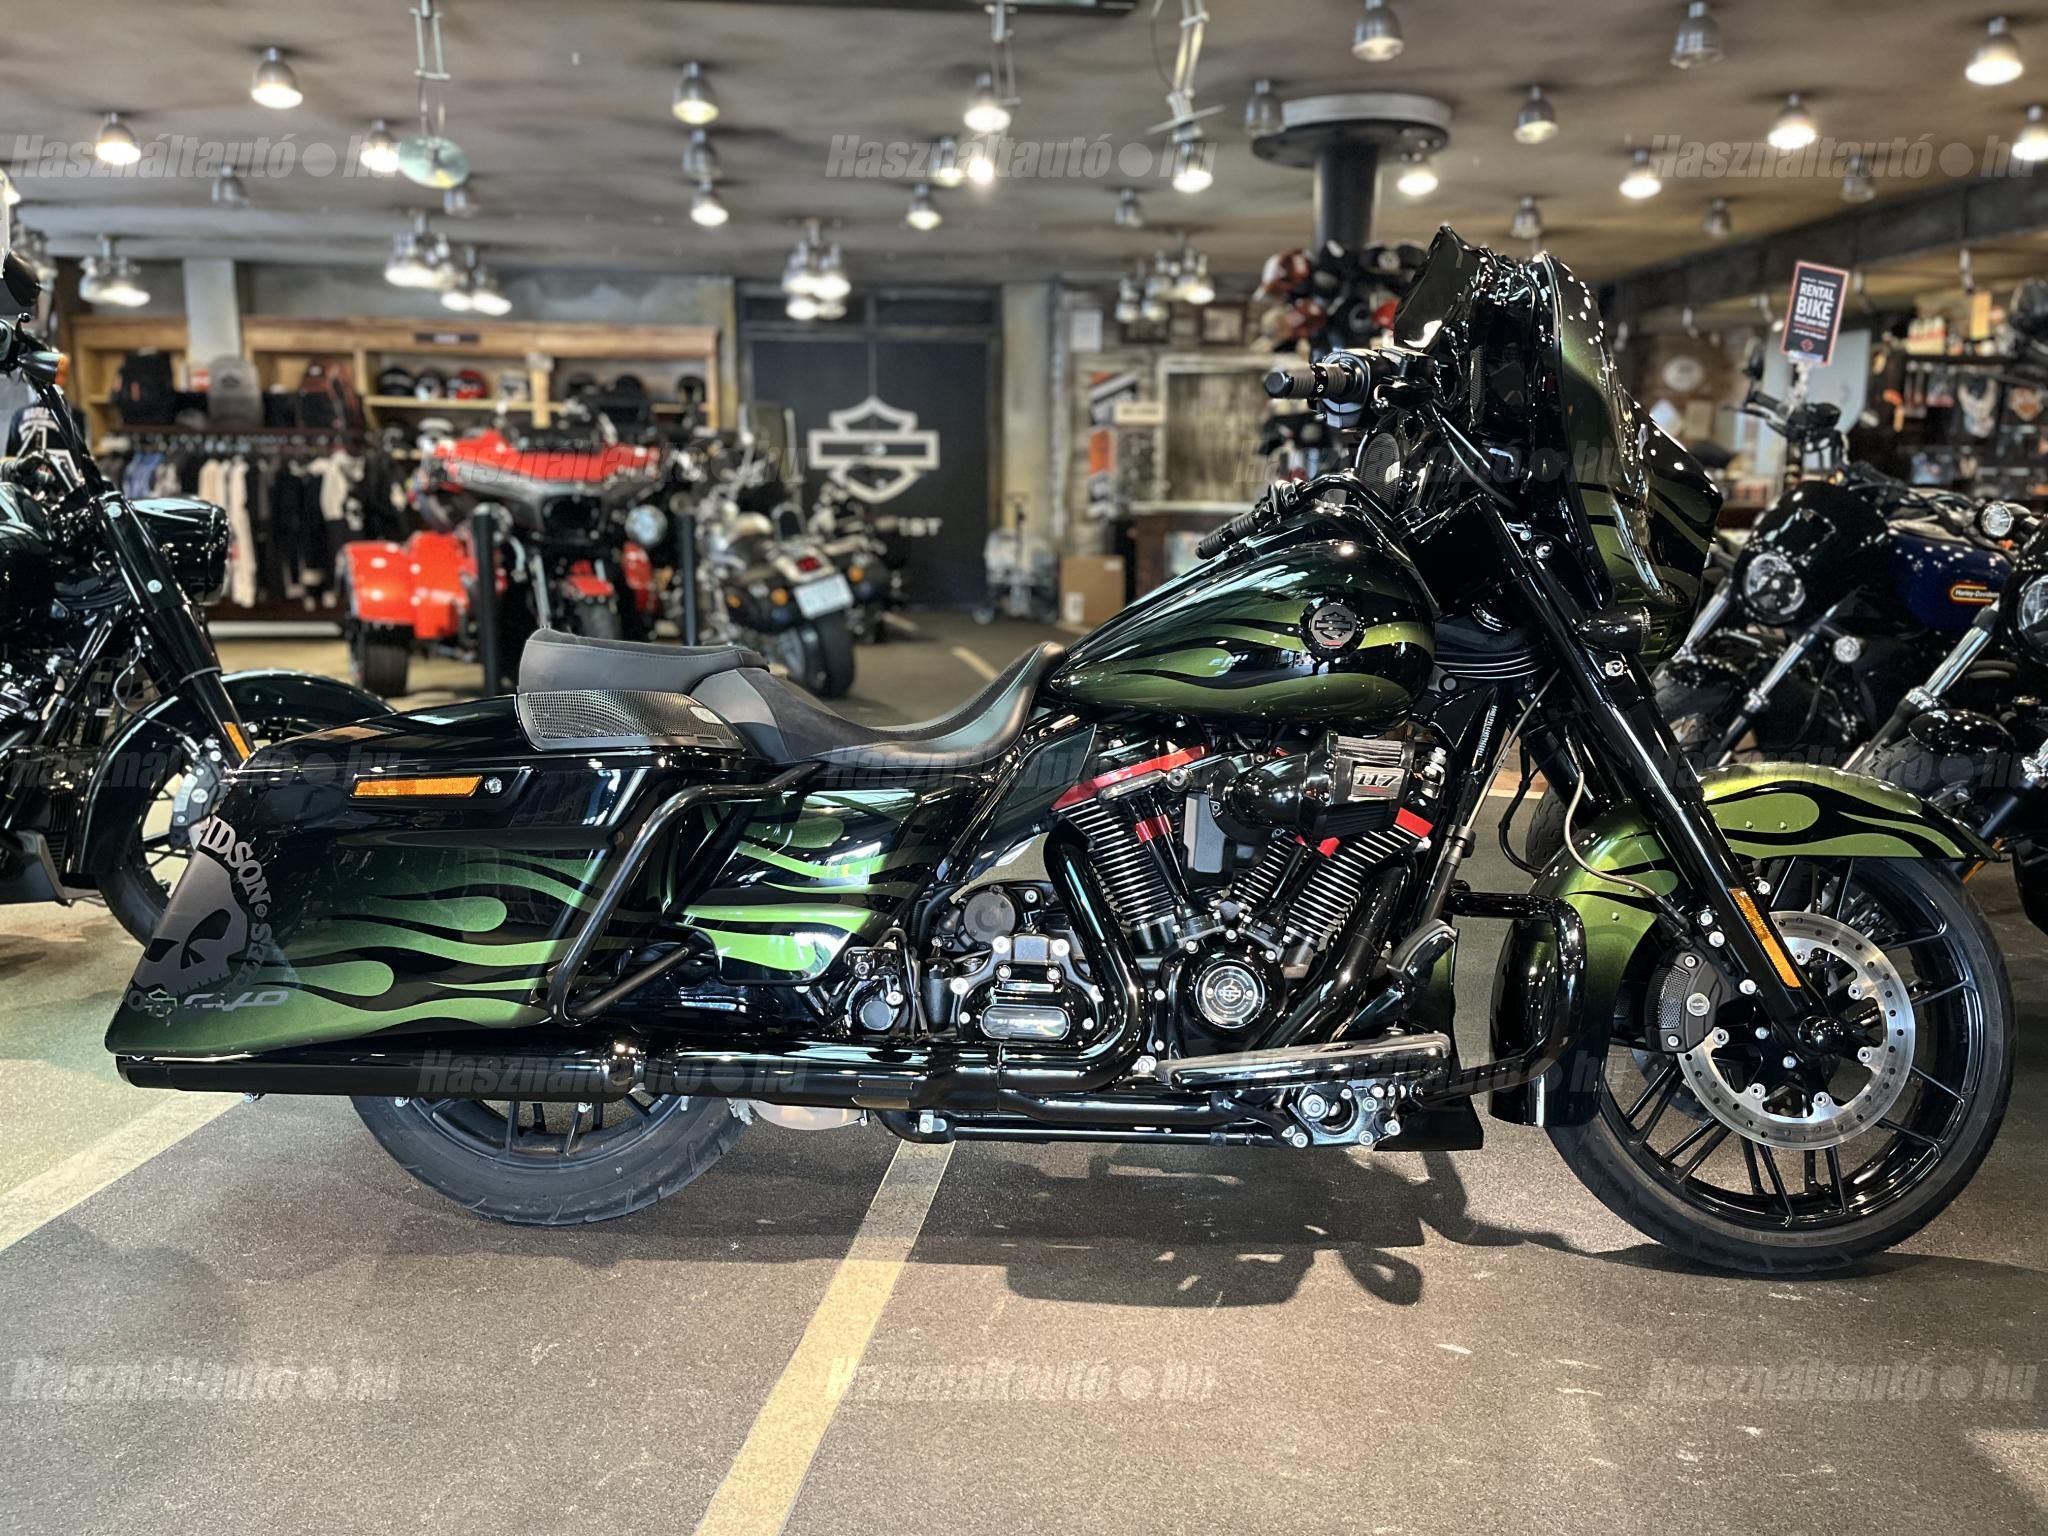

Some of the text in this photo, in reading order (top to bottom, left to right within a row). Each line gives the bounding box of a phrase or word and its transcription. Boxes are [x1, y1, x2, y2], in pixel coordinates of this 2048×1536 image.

[1800, 282, 1835, 302] RENTAL
[1796, 296, 1834, 321] BIKE
[1355, 771, 1402, 788] 117
